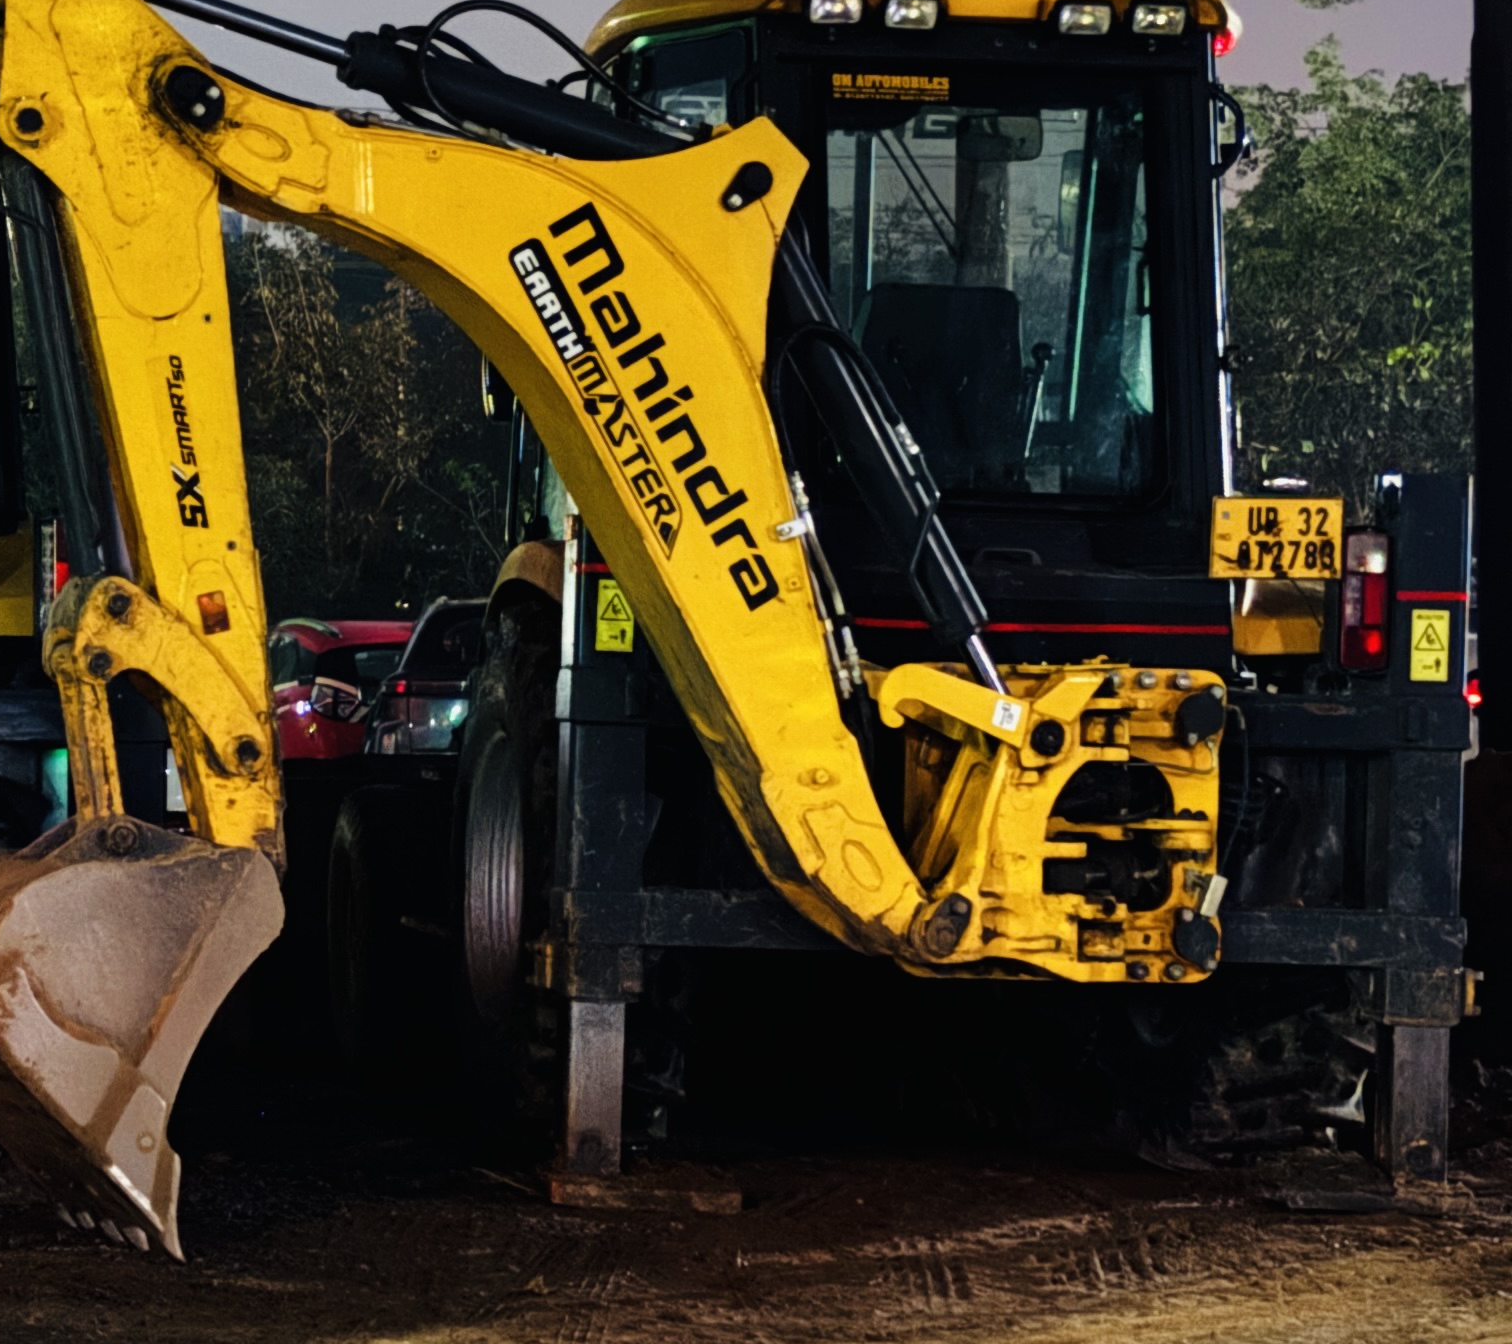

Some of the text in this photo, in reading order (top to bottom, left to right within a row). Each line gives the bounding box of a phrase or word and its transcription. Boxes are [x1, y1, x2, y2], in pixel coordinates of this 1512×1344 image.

[855, 75, 949, 90] AUTOMOBILES
[548, 202, 779, 611] Mahindra
[1248, 506, 1330, 537] UP 32
